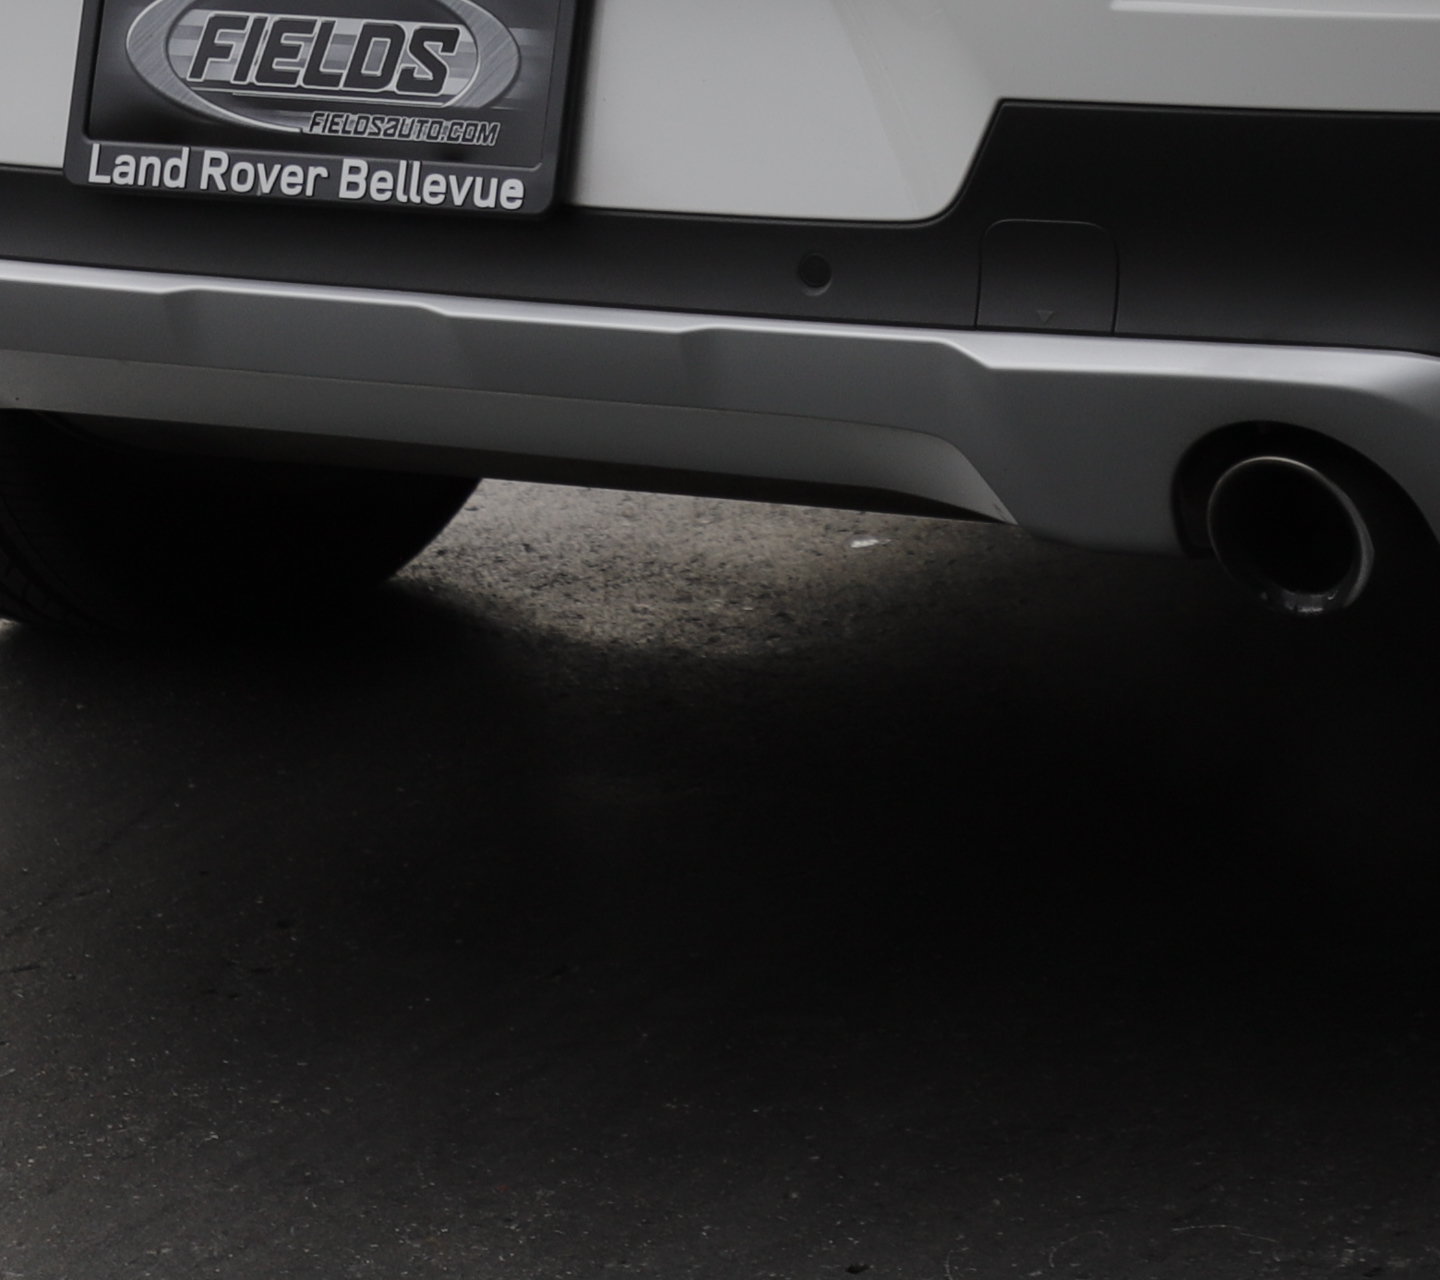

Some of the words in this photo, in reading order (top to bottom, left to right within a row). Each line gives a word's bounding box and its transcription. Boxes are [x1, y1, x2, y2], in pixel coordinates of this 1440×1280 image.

[187, 11, 462, 97] FIELDS
[87, 143, 190, 190] Land
[199, 150, 329, 198] Rover
[338, 158, 526, 210] Bellevue
